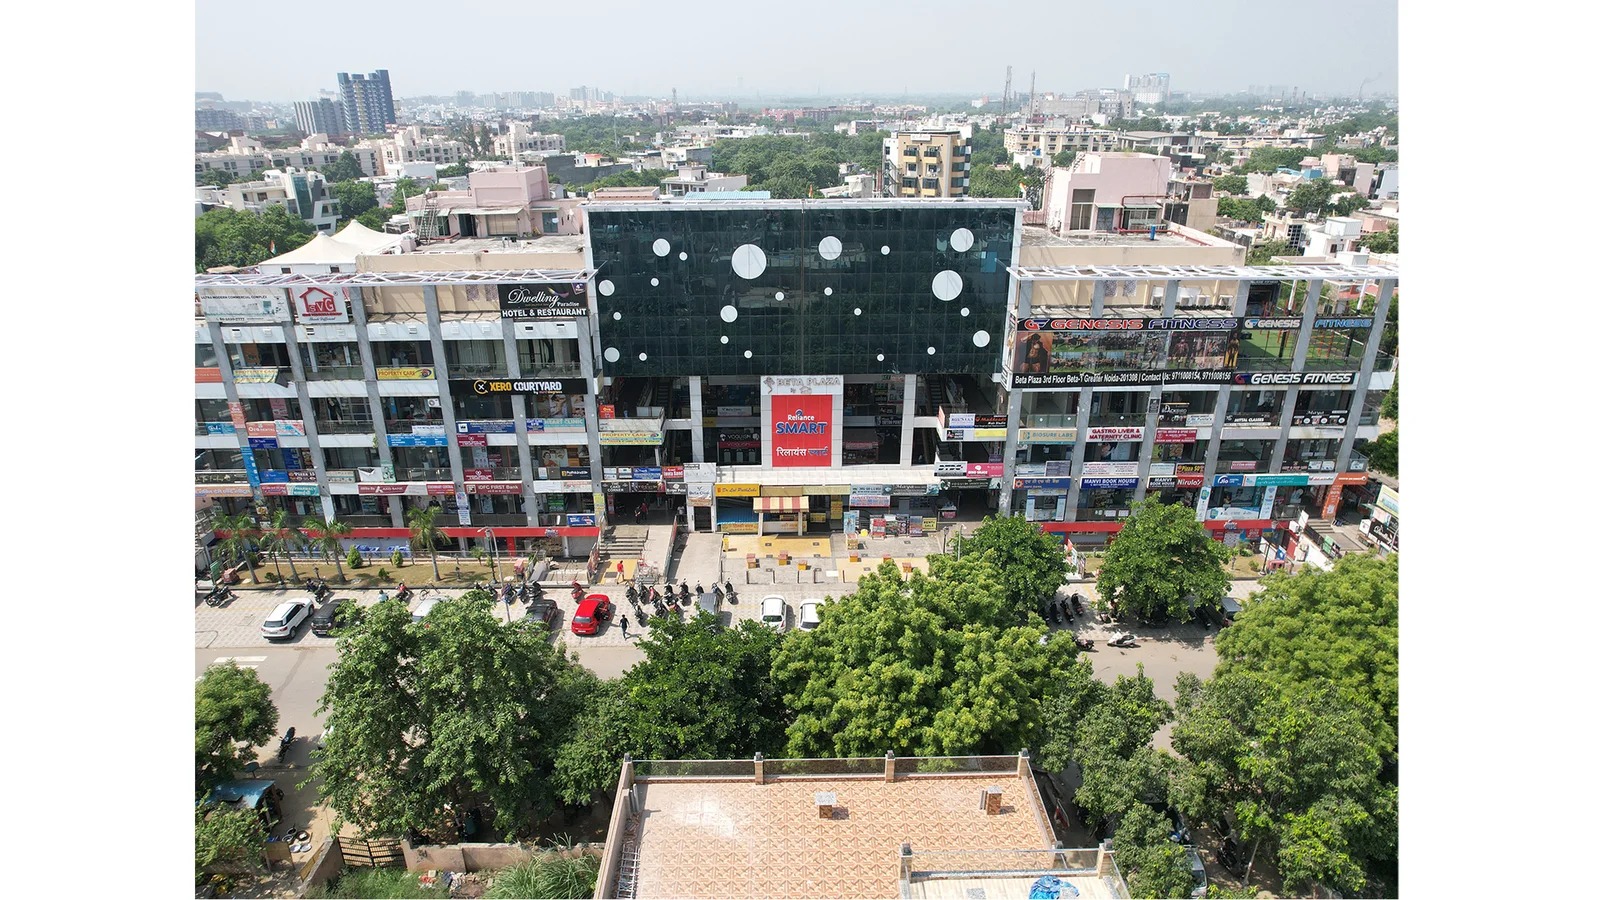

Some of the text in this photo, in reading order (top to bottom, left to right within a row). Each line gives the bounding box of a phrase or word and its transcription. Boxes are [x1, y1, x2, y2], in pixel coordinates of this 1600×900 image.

[508, 288, 560, 308] Dwelling
[502, 310, 527, 318] HOTEL
[1051, 318, 1238, 330] GENESIS FITNESS
[1257, 319, 1373, 328] GENESIS FITNESS
[776, 379, 841, 387] BETA PLAZA
[1015, 375, 1027, 384] Beta
[1028, 375, 1042, 384] Plaza
[1043, 375, 1052, 383] 3rd
[1053, 374, 1066, 383] Floor
[1084, 373, 1103, 382] Greater
[1142, 373, 1161, 382] Contact
[1251, 373, 1353, 384] GENESIS FITNESS
[489, 383, 563, 392] XERO COURTYARD
[776, 422, 828, 436] SMART
[1058, 432, 1074, 440] LABS
[776, 446, 807, 457] रिलायंस
